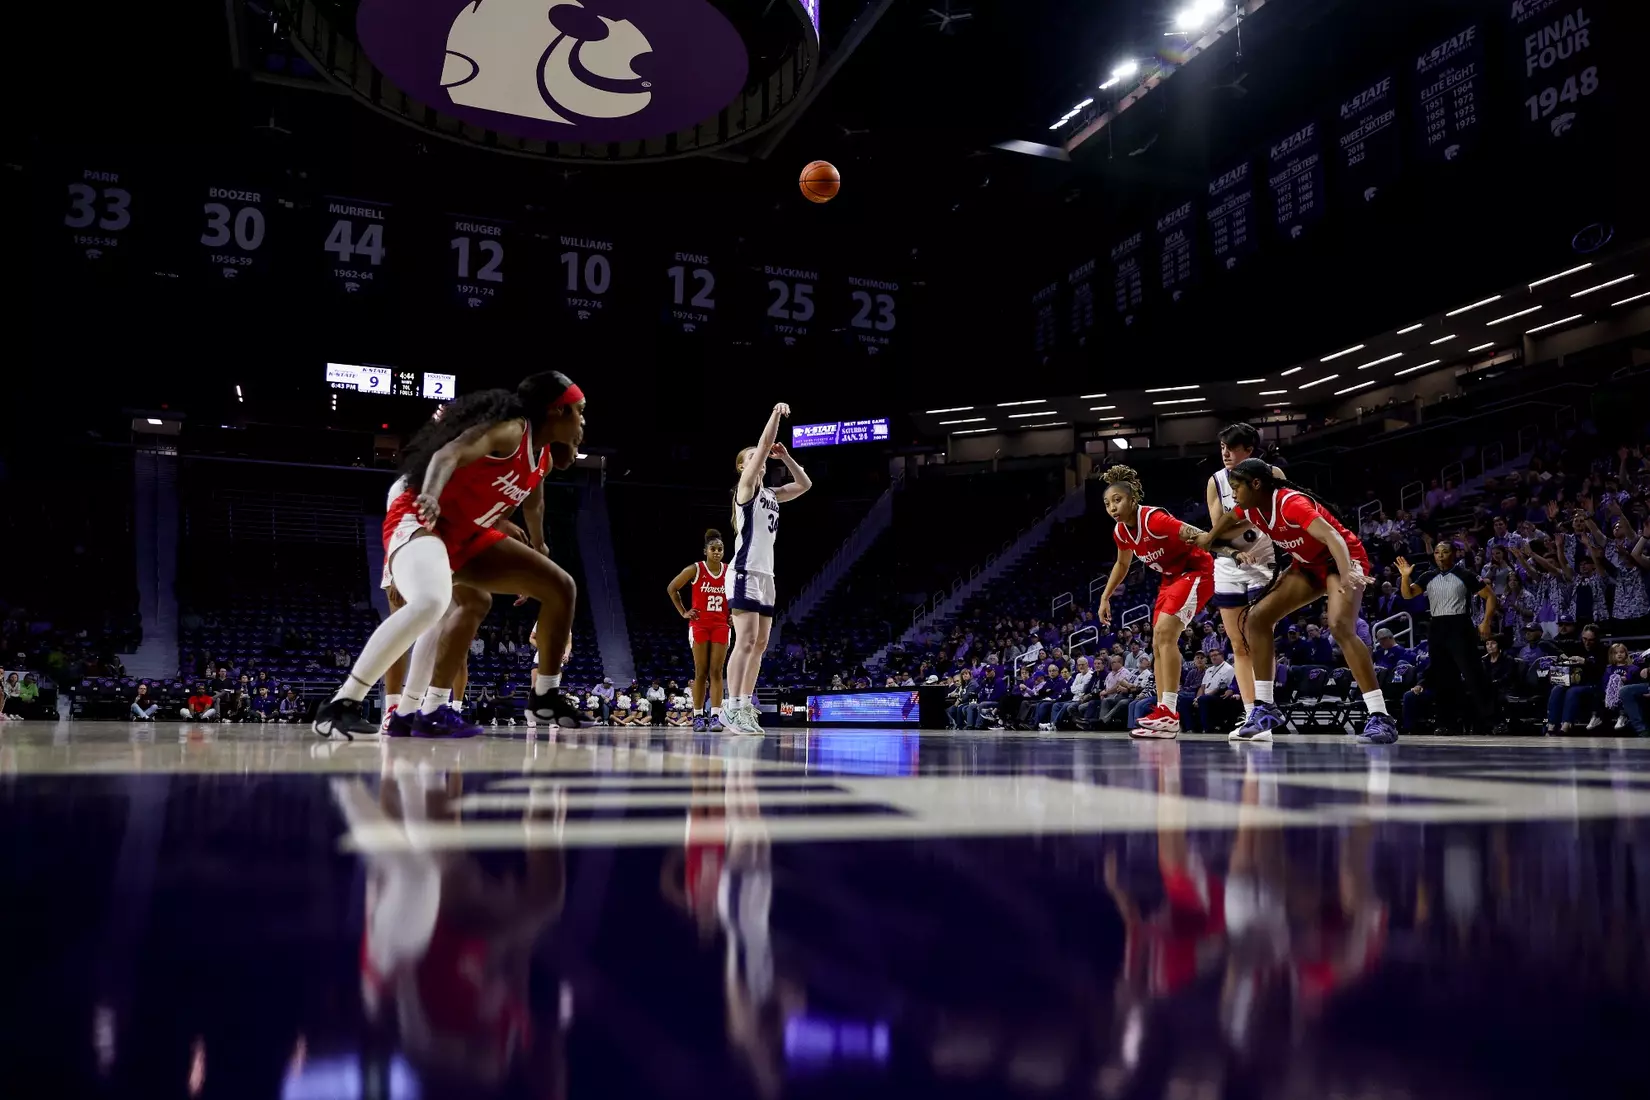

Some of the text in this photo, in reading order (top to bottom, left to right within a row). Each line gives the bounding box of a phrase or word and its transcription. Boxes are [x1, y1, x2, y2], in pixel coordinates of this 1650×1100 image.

[1525, 7, 1591, 56] FINAL
[1416, 25, 1476, 70] K-STATE
[1526, 29, 1591, 78] FOUR
[1420, 63, 1475, 100] ELITE EIGHT
[1453, 80, 1472, 97] 1964
[1340, 76, 1391, 116] K-STATE
[1454, 92, 1474, 109] 1972
[1524, 65, 1599, 122] 1948
[1425, 97, 1443, 112] 1951
[1454, 103, 1475, 120] 1973
[1426, 107, 1445, 122] 1958
[1456, 114, 1476, 131] 1975
[1340, 108, 1395, 146] SWEET SIXTEEN
[1427, 118, 1446, 134] 1959
[1270, 121, 1314, 159] K-STATE
[1428, 129, 1446, 148] 1961
[84, 169, 119, 182] PARR
[1208, 160, 1249, 194] K-STATE
[1269, 168, 1290, 187] SWEET
[1291, 153, 1318, 175] SIXTEEN
[209, 187, 261, 203] BOOZER
[64, 182, 132, 231] 33
[329, 203, 385, 220] MURRELL
[1156, 200, 1192, 230] K-STATE
[200, 202, 265, 251] 30
[454, 221, 501, 236] KRUGER
[74, 235, 118, 247] 1955-58
[324, 219, 386, 266] 44
[560, 235, 613, 251] WILLIAMS
[1110, 230, 1142, 259] K-STATE
[1165, 229, 1185, 246] NCAA
[211, 254, 253, 266] 1956-59
[450, 236, 504, 283] 12
[675, 252, 709, 265] EVANS
[334, 269, 373, 280] 1962-64
[560, 251, 611, 295] 10
[764, 265, 818, 280] BLACKMAN
[457, 285, 495, 297] 1971-74
[667, 265, 716, 310] 12
[848, 276, 899, 291] RICHMOND
[567, 297, 602, 309] 1972-76
[767, 279, 815, 321] 25
[673, 310, 708, 322] 1974-78
[851, 290, 896, 331] 23
[369, 376, 379, 388] 9
[399, 372, 415, 381] 4:44
[434, 382, 443, 394] 2
[804, 424, 838, 434] K-STATE
[491, 469, 531, 507] Houst
[706, 595, 724, 612] 22
